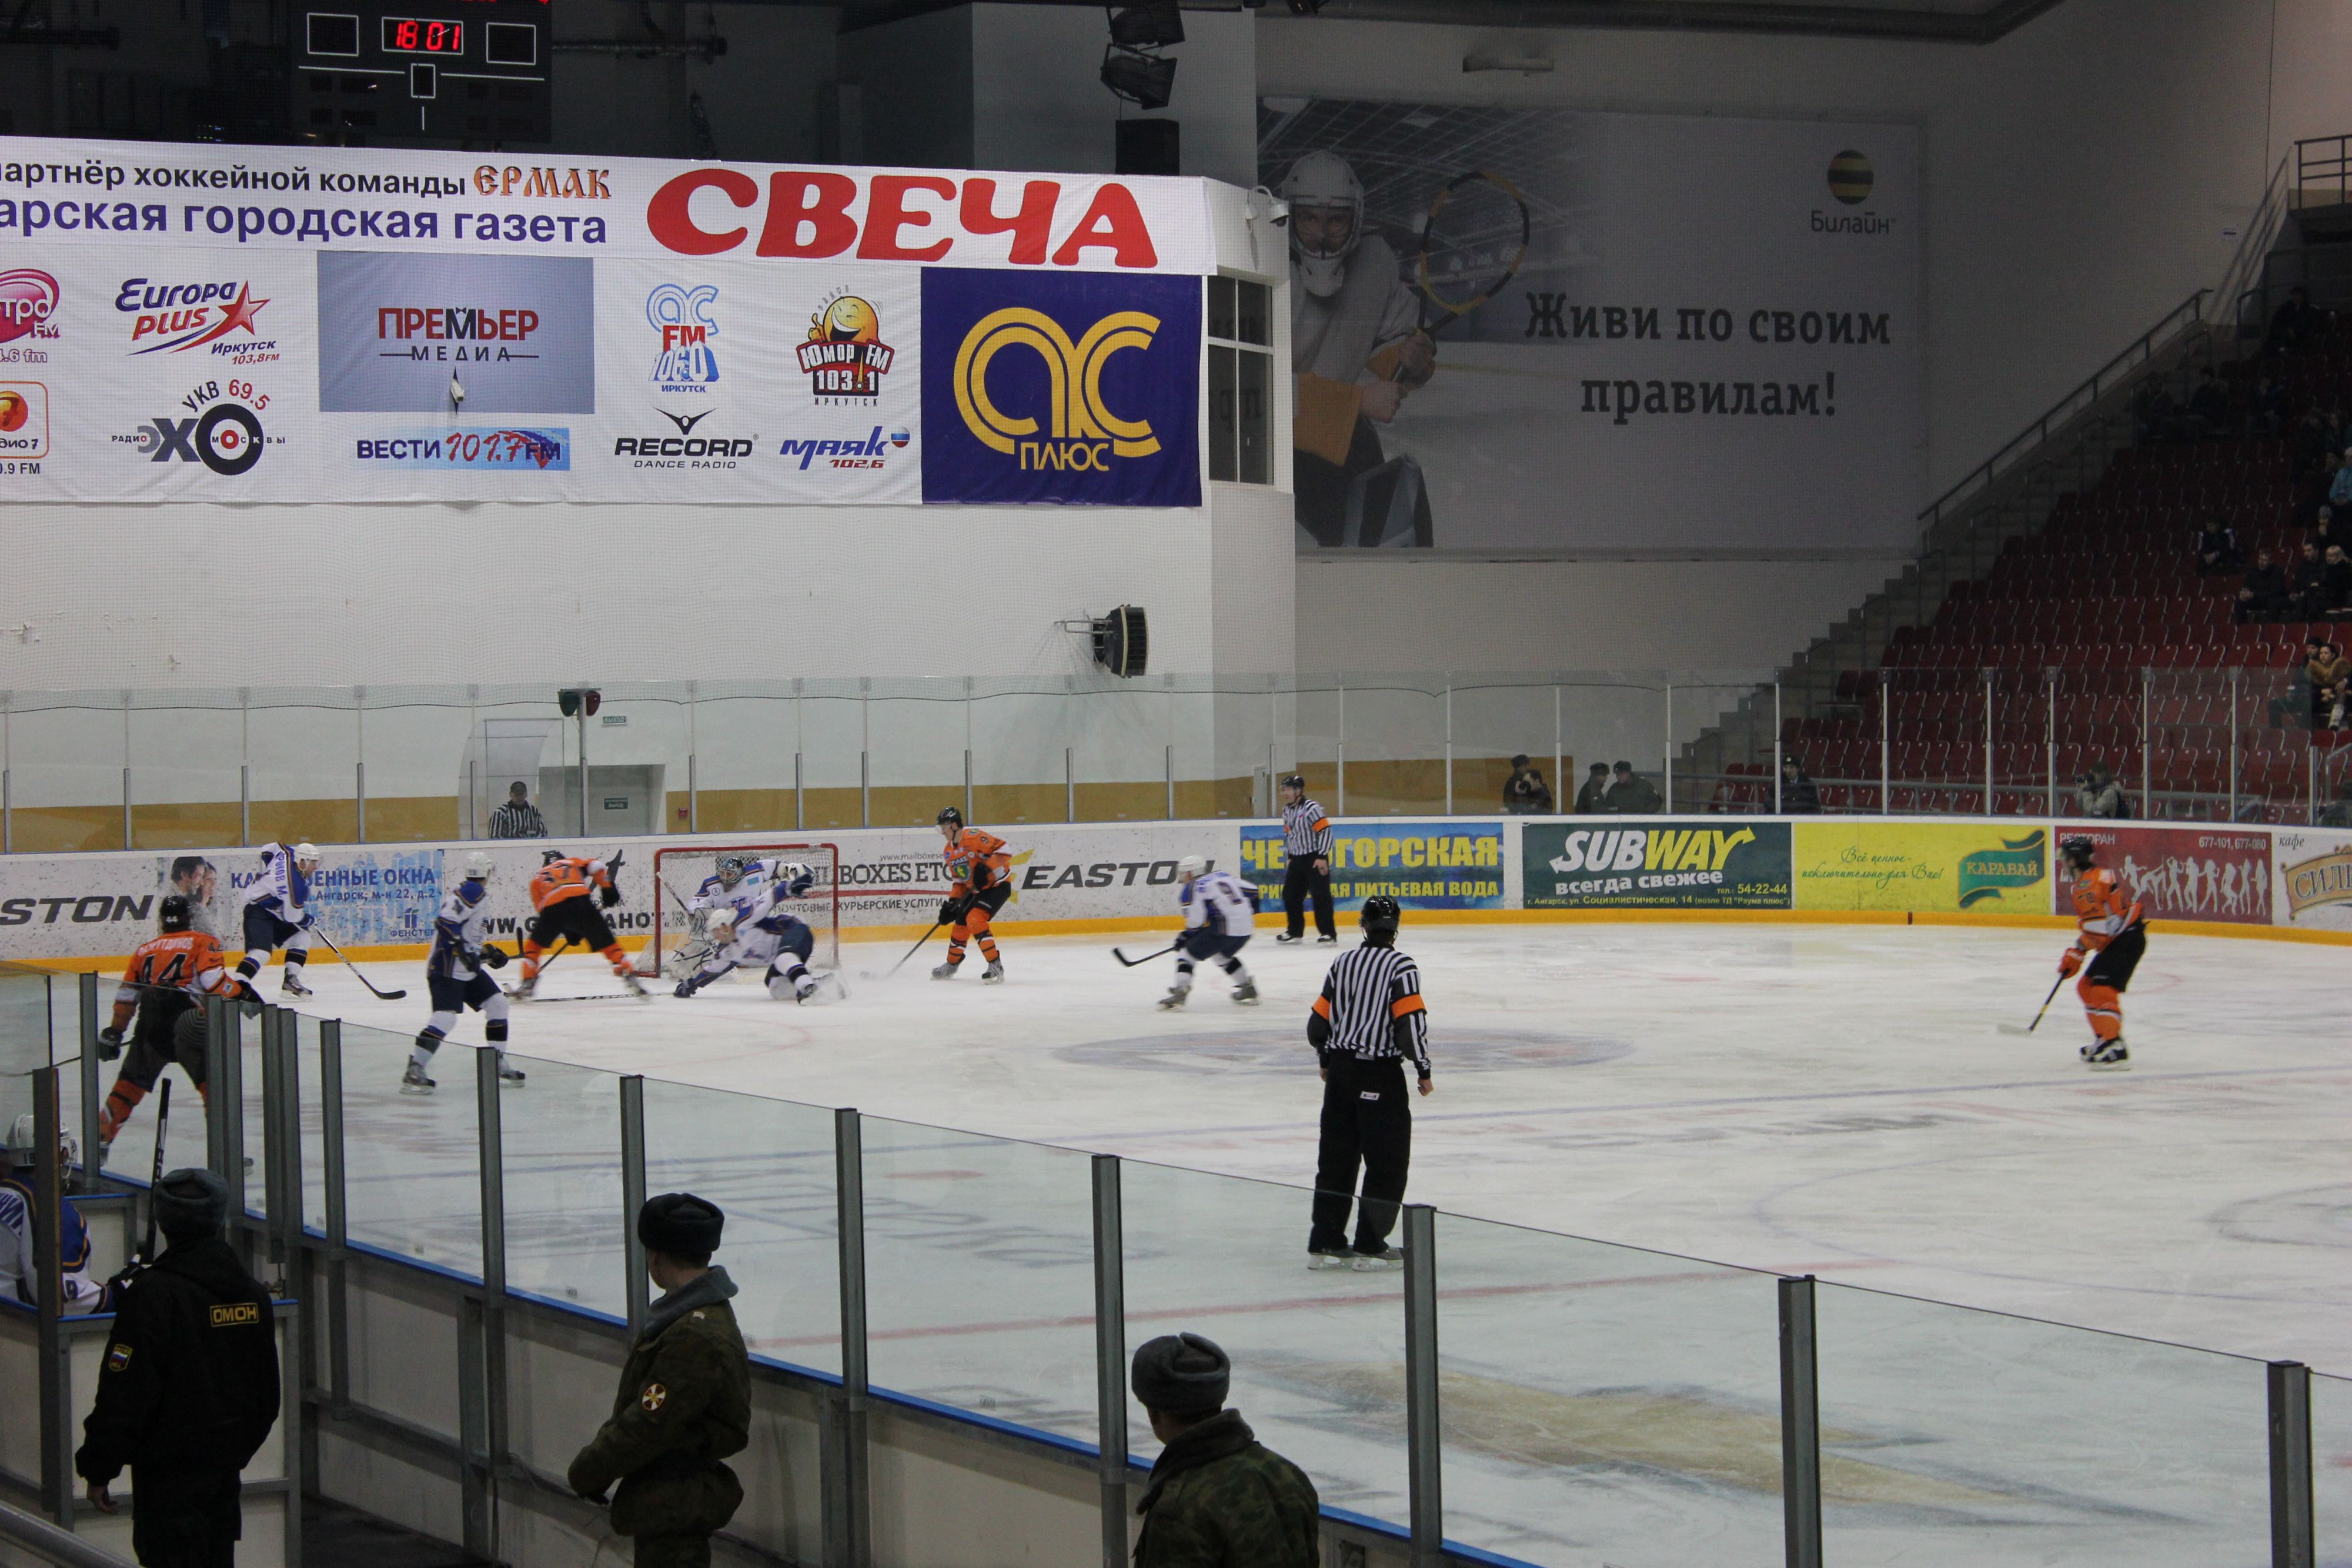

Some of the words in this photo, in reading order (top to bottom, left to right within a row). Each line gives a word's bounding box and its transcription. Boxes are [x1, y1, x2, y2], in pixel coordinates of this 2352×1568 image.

[0, 159, 125, 190] артнёр
[134, 165, 310, 191] хоккейной
[320, 172, 466, 199] команды
[184, 205, 438, 243] городская
[454, 212, 607, 244] газета
[646, 168, 1158, 269] СВЕЧА
[115, 278, 237, 312] Europa
[0, 298, 52, 325] тро
[1525, 292, 1661, 340] Живи
[1676, 307, 1733, 342] по
[1749, 309, 1891, 345] своим
[32, 320, 60, 338] FM
[378, 307, 539, 340] ПРЕМЬЕР
[211, 340, 276, 355] Иркутск
[663, 325, 705, 353] FM
[0, 348, 20, 363] .6
[24, 348, 48, 363] fm
[411, 346, 510, 362] МЕДИА
[866, 343, 891, 372] FM
[182, 380, 220, 413] УКВ
[229, 379, 270, 410] 69.5
[662, 385, 706, 393] ИРКУТСК
[1581, 371, 1836, 426] правилам!
[815, 397, 877, 406] ИРКУТСК
[112, 435, 147, 443] РАДИО
[614, 437, 753, 457] RECORD
[356, 439, 441, 460] ВЕСТИ
[1020, 441, 1110, 472] ПЛЮС
[20, 463, 41, 474] FM
[634, 460, 686, 469] DANCE
[691, 461, 736, 469] RADIO
[829, 459, 885, 470] 102,6
[1549, 826, 1757, 874] SUBWAY
[2279, 834, 2304, 850] кафе
[880, 852, 943, 861] www.mailboxese
[1242, 837, 1498, 870] ЧЕГОРСКАЯ
[1841, 846, 1868, 863] Всё
[384, 868, 436, 885] ОКНА
[839, 862, 911, 885] BOXES
[1802, 862, 1883, 879] исключительно
[1876, 870, 1909, 890] для
[1912, 862, 1945, 880] Вас!
[1966, 860, 2037, 877] КАРАВАЙ
[1354, 882, 1445, 899] ПИТЬЕВАЯ
[1448, 881, 1499, 899] ВОДА
[1555, 877, 1632, 895] всегда
[1638, 871, 1723, 889] свежее
[1737, 883, 1788, 895] 54-22-44
[1681, 895, 1692, 904] 14
[213, 1306, 256, 1323] ОМОН
